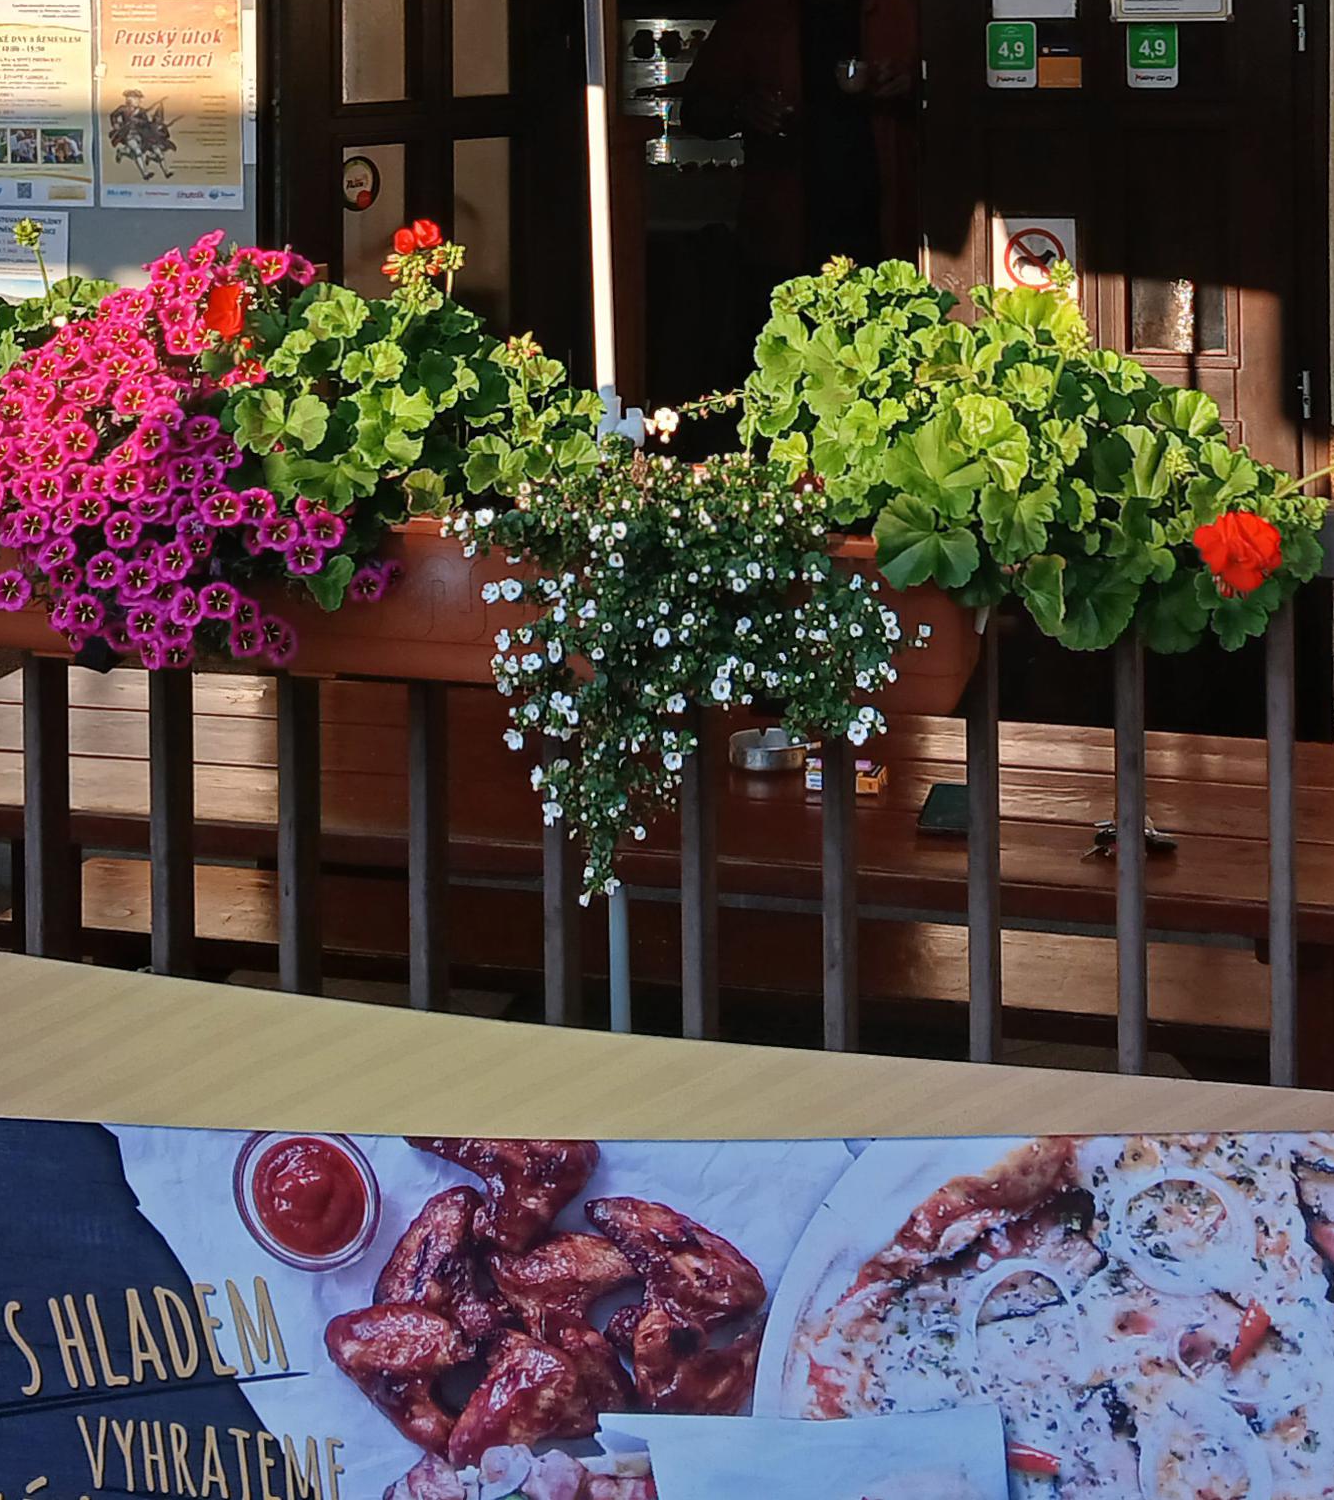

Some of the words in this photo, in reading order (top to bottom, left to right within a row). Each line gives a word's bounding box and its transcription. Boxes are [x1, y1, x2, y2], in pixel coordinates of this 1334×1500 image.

[114, 27, 178, 48] Pruský
[181, 27, 224, 45] útok
[998, 41, 1025, 60] 4,9
[1138, 39, 1166, 59] 4,9
[131, 53, 155, 67] na
[4, 1300, 40, 1396] S
[48, 1275, 288, 1389] HLADEM
